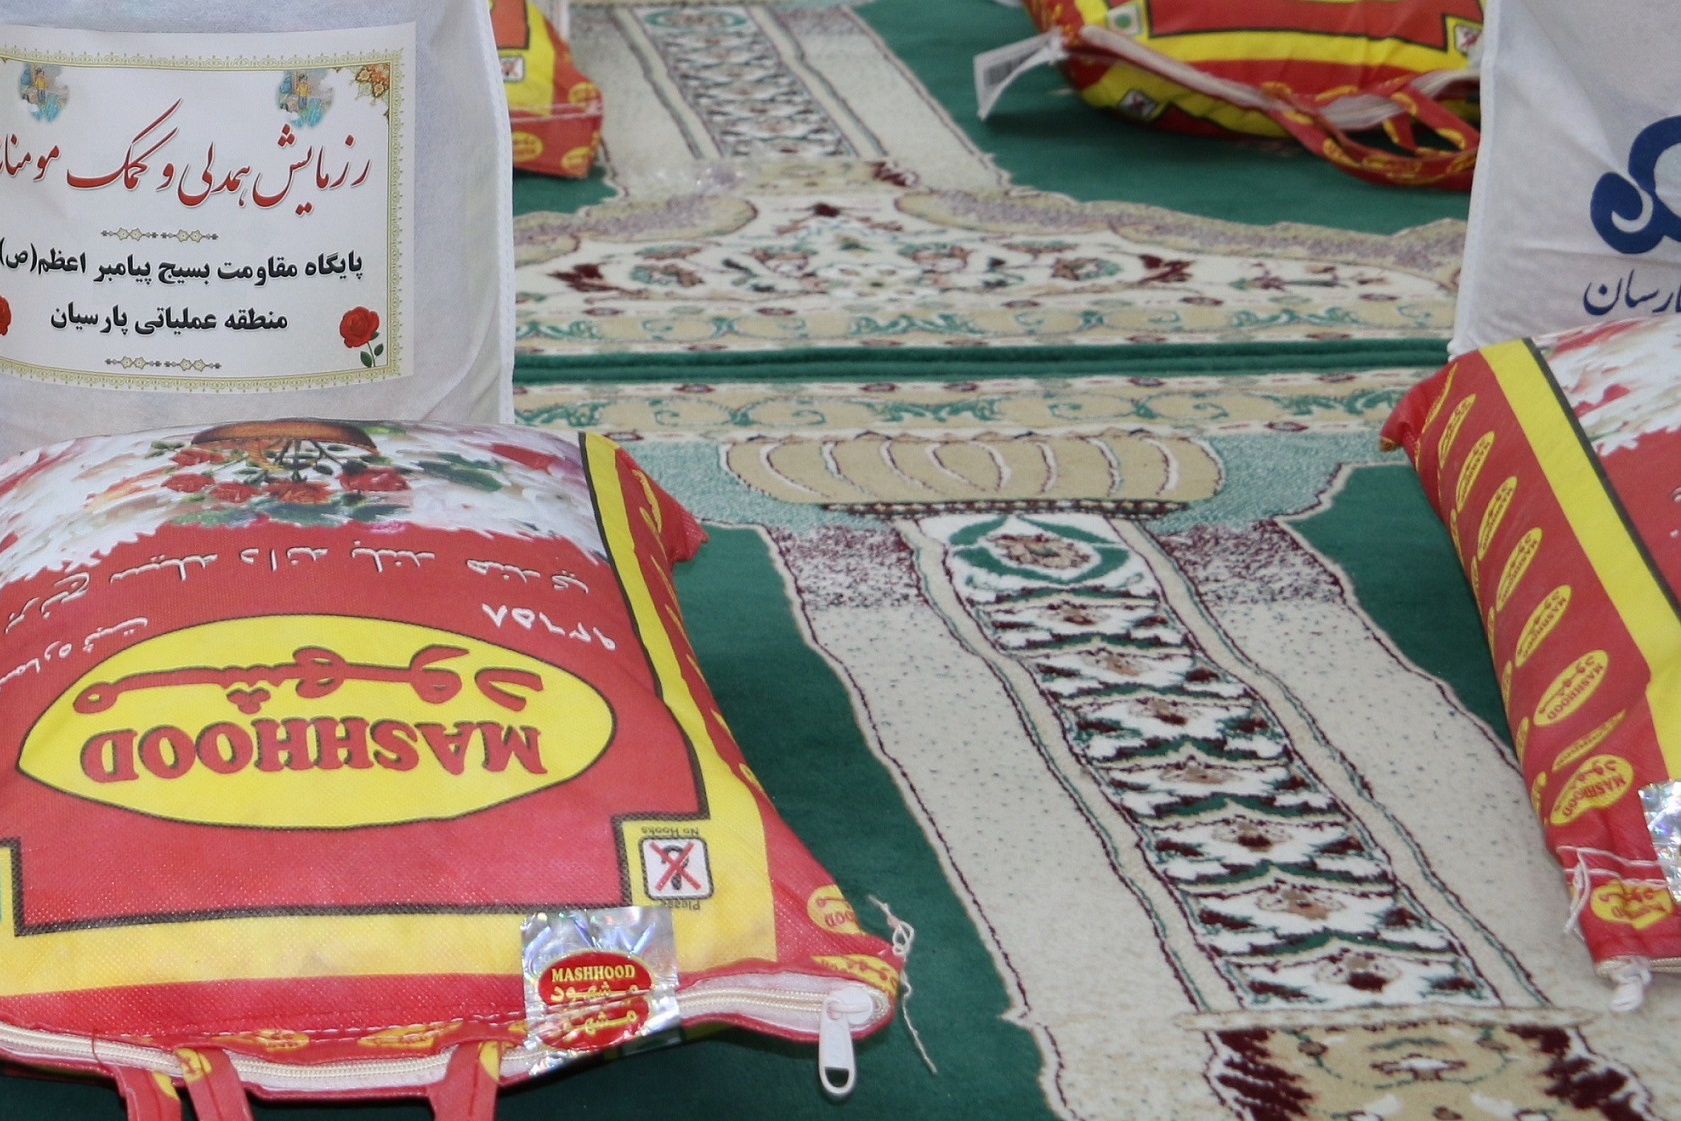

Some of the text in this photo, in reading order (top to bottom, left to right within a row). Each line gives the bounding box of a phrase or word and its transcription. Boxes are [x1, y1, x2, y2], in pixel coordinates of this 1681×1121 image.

[65, 97, 184, 192] کمک
[155, 160, 176, 192] و
[176, 141, 252, 208] همدلی
[252, 123, 372, 216] رزمایش
[93, 253, 152, 286] پیامبر
[156, 261, 211, 285] بسیج
[217, 253, 299, 287] مقاومت
[304, 250, 364, 281] پایگاه
[50, 301, 289, 337] منطقه عملیاتی پارسیان
[239, 546, 328, 570] دانه
[349, 544, 437, 570] بلند
[82, 614, 149, 655] ثبت
[73, 644, 545, 716] مشهود
[1546, 662, 1605, 721] MASHHOOD
[80, 716, 548, 784] MASHHOOD
[550, 964, 636, 983] MASHHOOD
